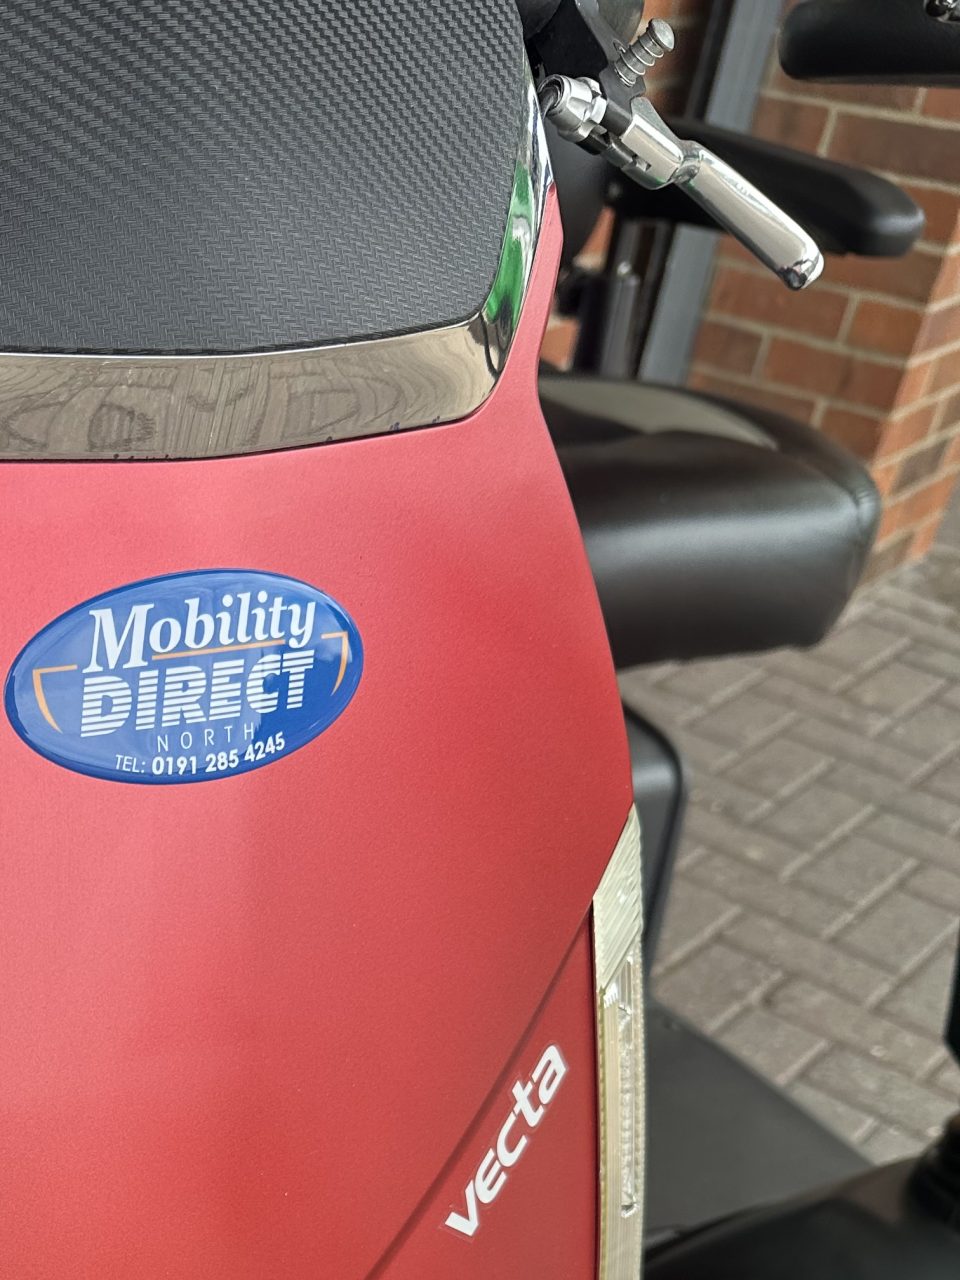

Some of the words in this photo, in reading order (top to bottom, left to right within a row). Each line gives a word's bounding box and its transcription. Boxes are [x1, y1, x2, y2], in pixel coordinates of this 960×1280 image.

[81, 590, 317, 674] Mobility
[80, 649, 315, 738] DIRECT
[115, 753, 146, 774] TEL:
[151, 755, 198, 776] 0191
[204, 748, 239, 774] 285
[243, 731, 286, 763] 4245
[157, 721, 257, 752] NORTH
